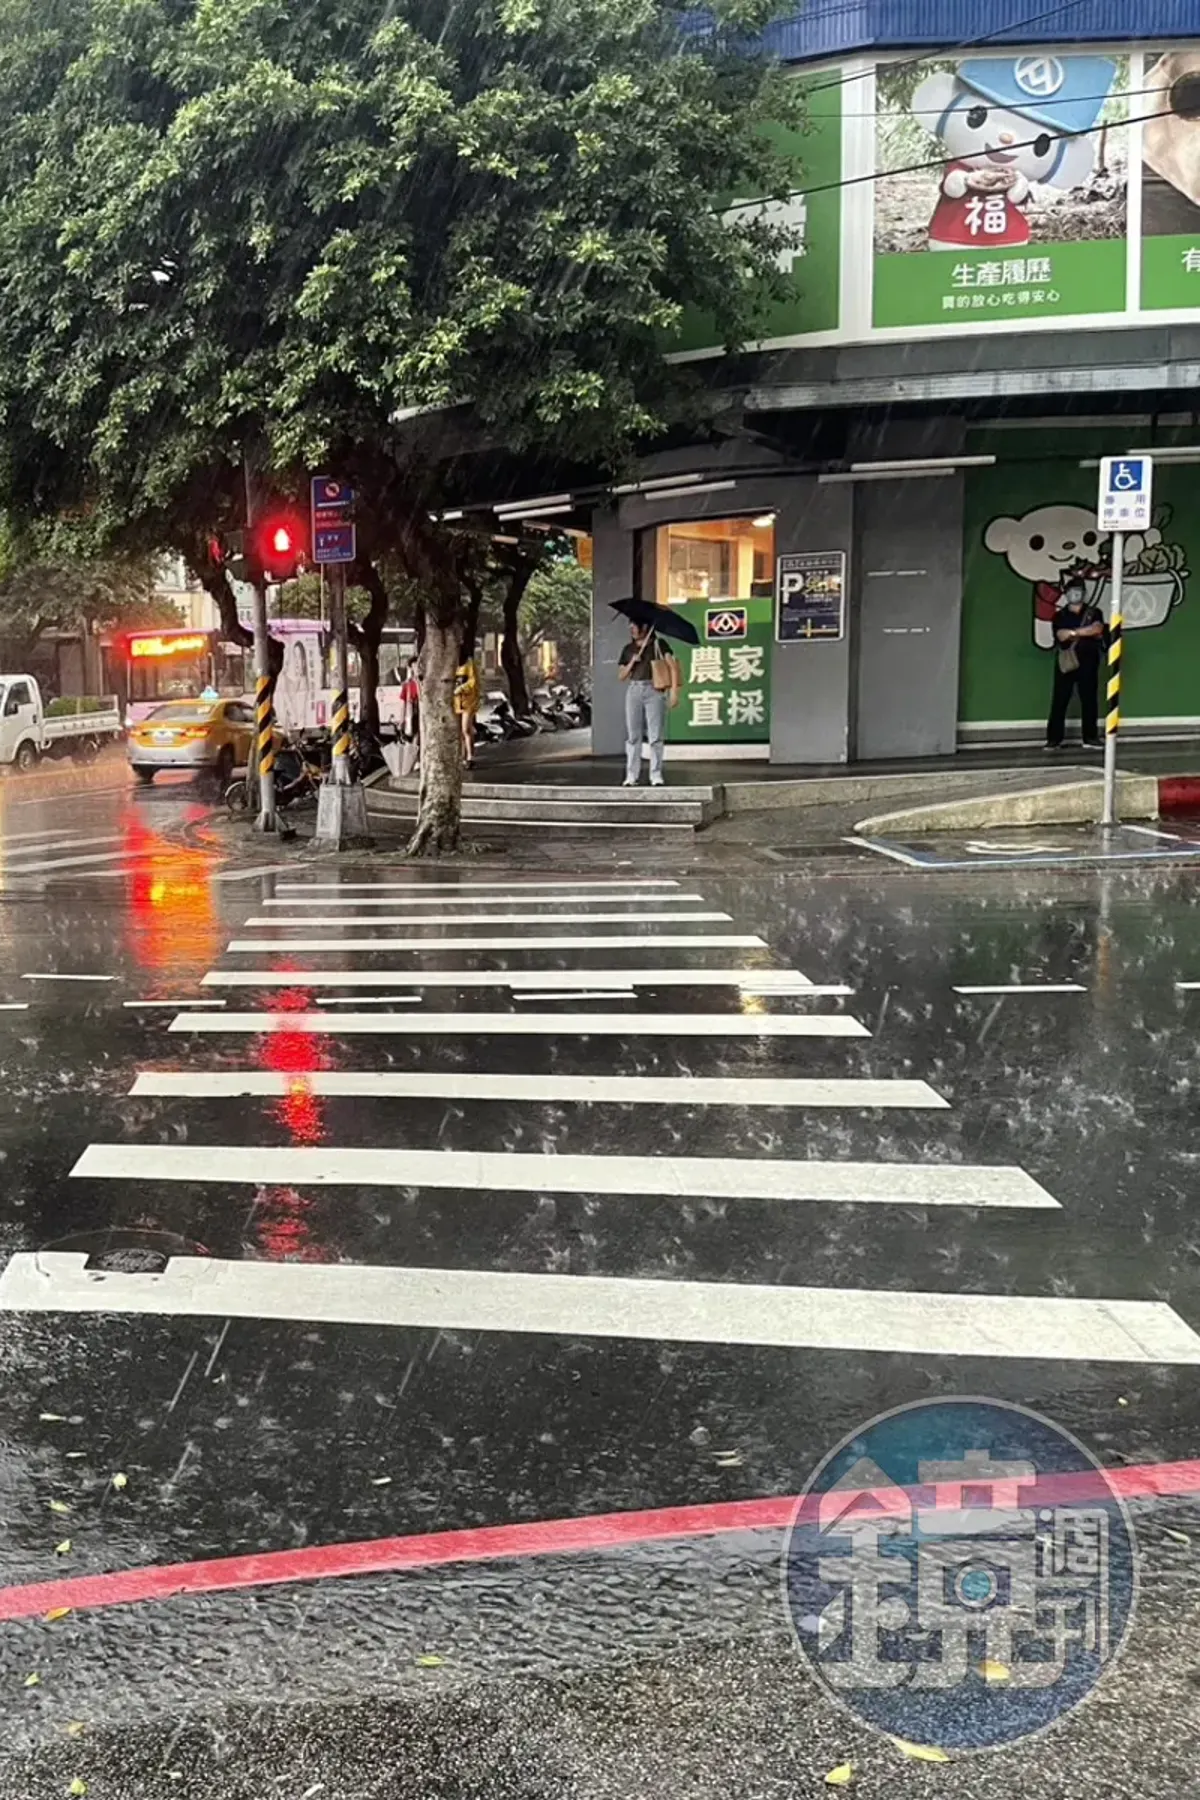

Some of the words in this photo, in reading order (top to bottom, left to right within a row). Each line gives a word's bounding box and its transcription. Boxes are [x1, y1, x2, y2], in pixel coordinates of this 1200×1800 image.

[964, 194, 1006, 235] 福
[951, 257, 1052, 288] 生產履歷
[942, 289, 1061, 310] 買的放心吃得安心
[781, 573, 805, 604] P
[689, 645, 765, 683] 農家
[688, 690, 765, 726] 直採
